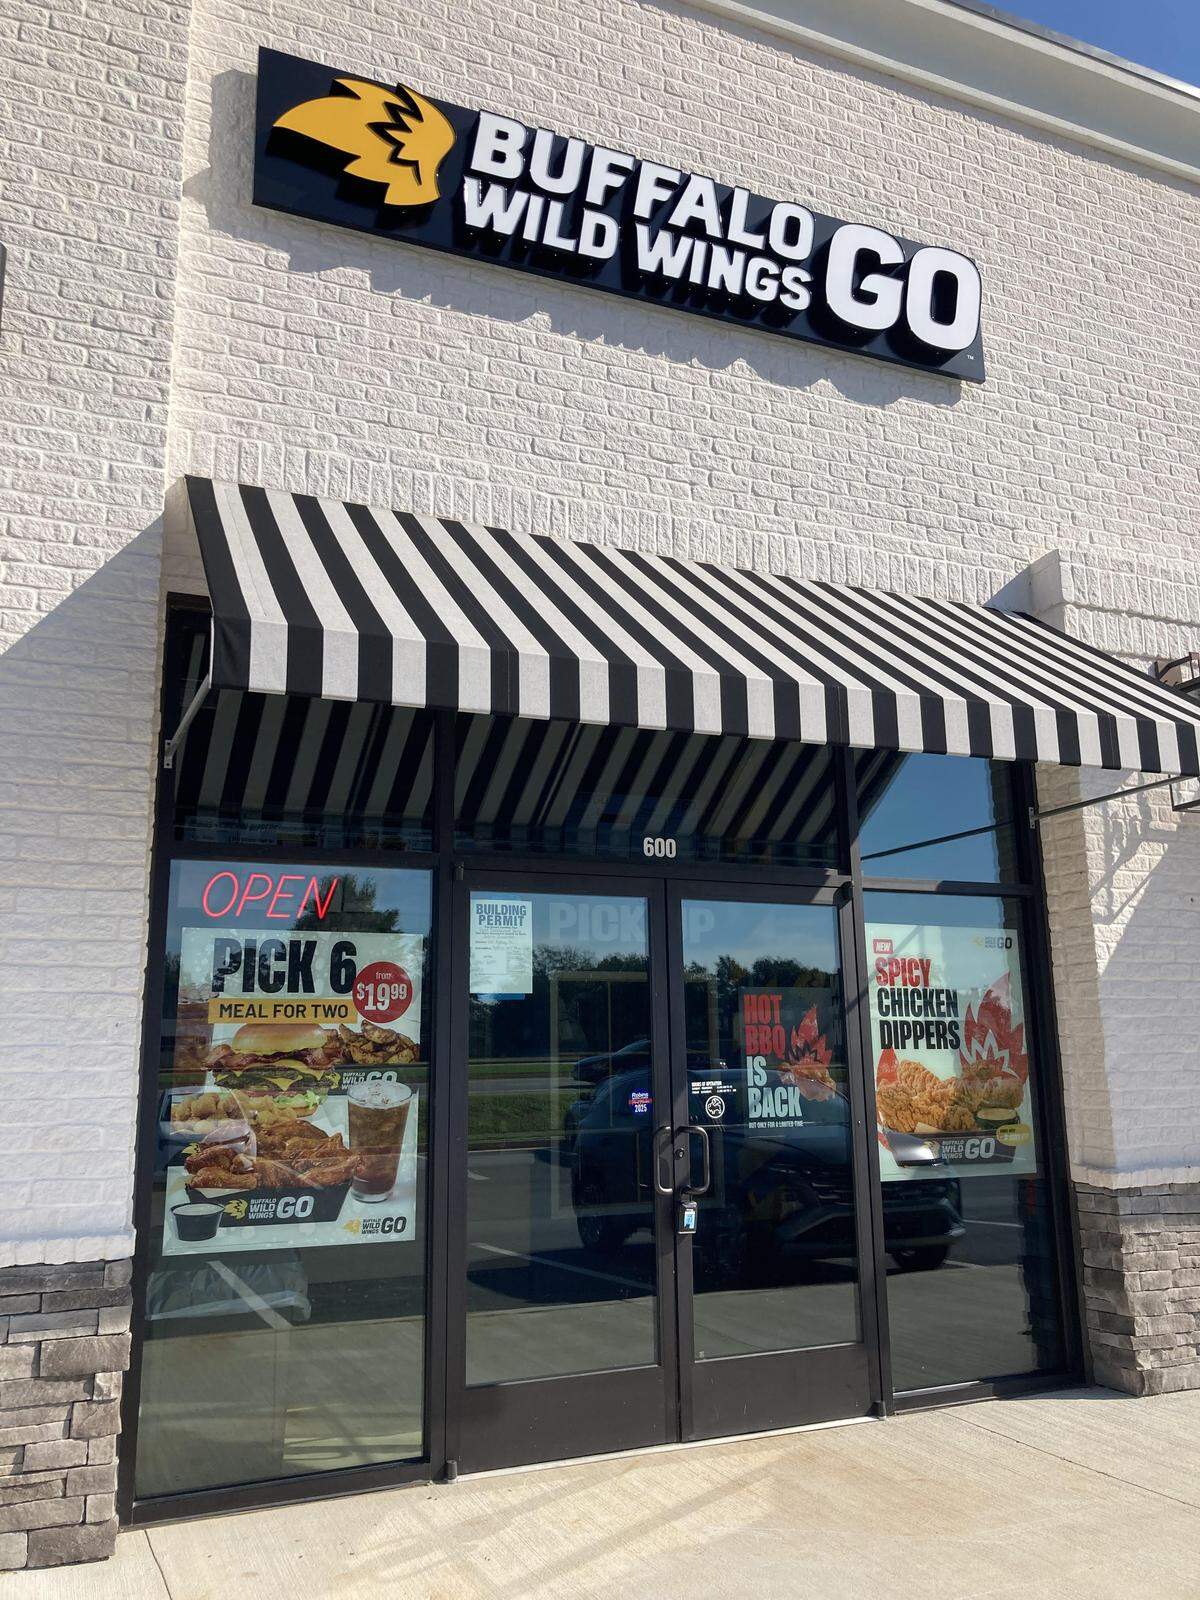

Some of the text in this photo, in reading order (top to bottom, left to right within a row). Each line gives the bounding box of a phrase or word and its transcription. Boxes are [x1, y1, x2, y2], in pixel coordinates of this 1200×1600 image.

[471, 109, 815, 260] BUFFALO
[463, 175, 813, 310] WILD WINGS
[825, 223, 982, 350] GO
[643, 837, 677, 858] 600
[202, 871, 340, 920] OPEN
[476, 903, 527, 916] BUILDING
[478, 914, 525, 927] PERMIT
[550, 902, 647, 943] PICK
[875, 941, 891, 952] NEW
[996, 936, 1013, 950] GO
[211, 937, 357, 994] PICK 6
[375, 971, 392, 980] from
[874, 957, 931, 988] SPICY
[219, 1003, 349, 1018] MEAL FOR TWO
[743, 993, 783, 1025] HOT
[877, 987, 960, 1018] CHICKEN
[745, 1024, 786, 1059] BBQ
[879, 1019, 960, 1050] DIPPERS
[747, 1055, 767, 1087] IS
[634, 1103, 648, 1113] 2025
[748, 1086, 802, 1118] BACK
[965, 1138, 995, 1159] GO
[248, 1212, 274, 1220] WINGS
[250, 1204, 276, 1212] WILD
[276, 1195, 315, 1219] GO
[381, 1216, 407, 1234] GO
